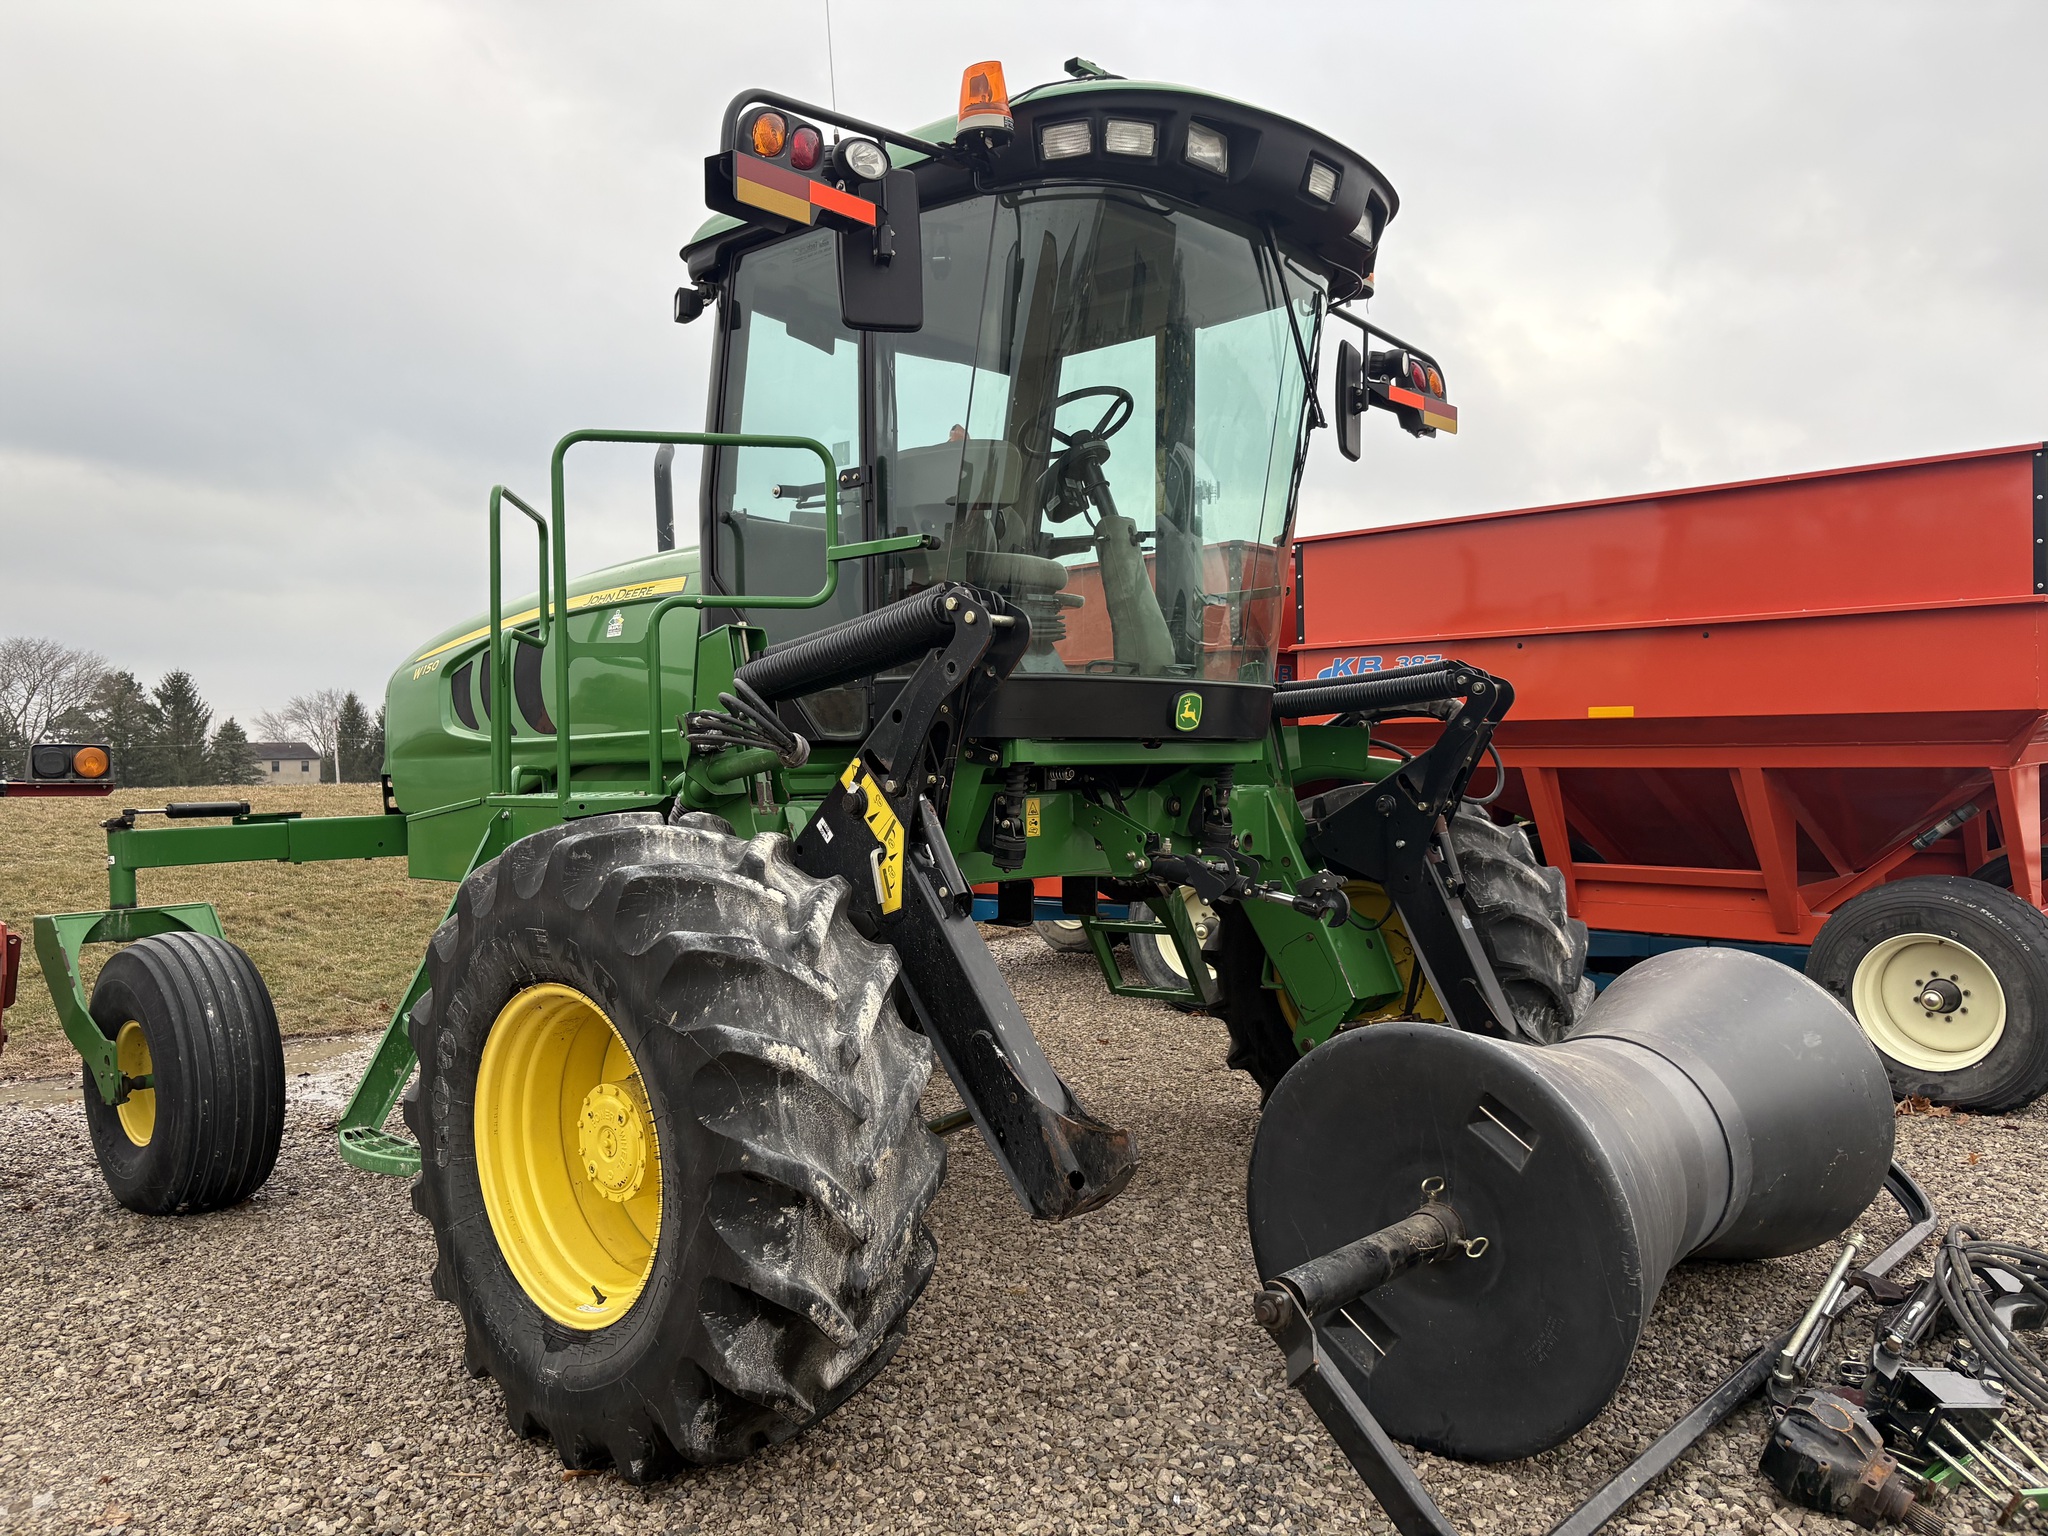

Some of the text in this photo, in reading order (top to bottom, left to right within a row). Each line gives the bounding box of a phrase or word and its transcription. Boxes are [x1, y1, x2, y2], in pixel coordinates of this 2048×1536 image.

[581, 586, 656, 607] JOHN DEERE
[413, 659, 440, 681] W150
[1331, 655, 1383, 679] KB
[592, 1108, 615, 1129] POWER
